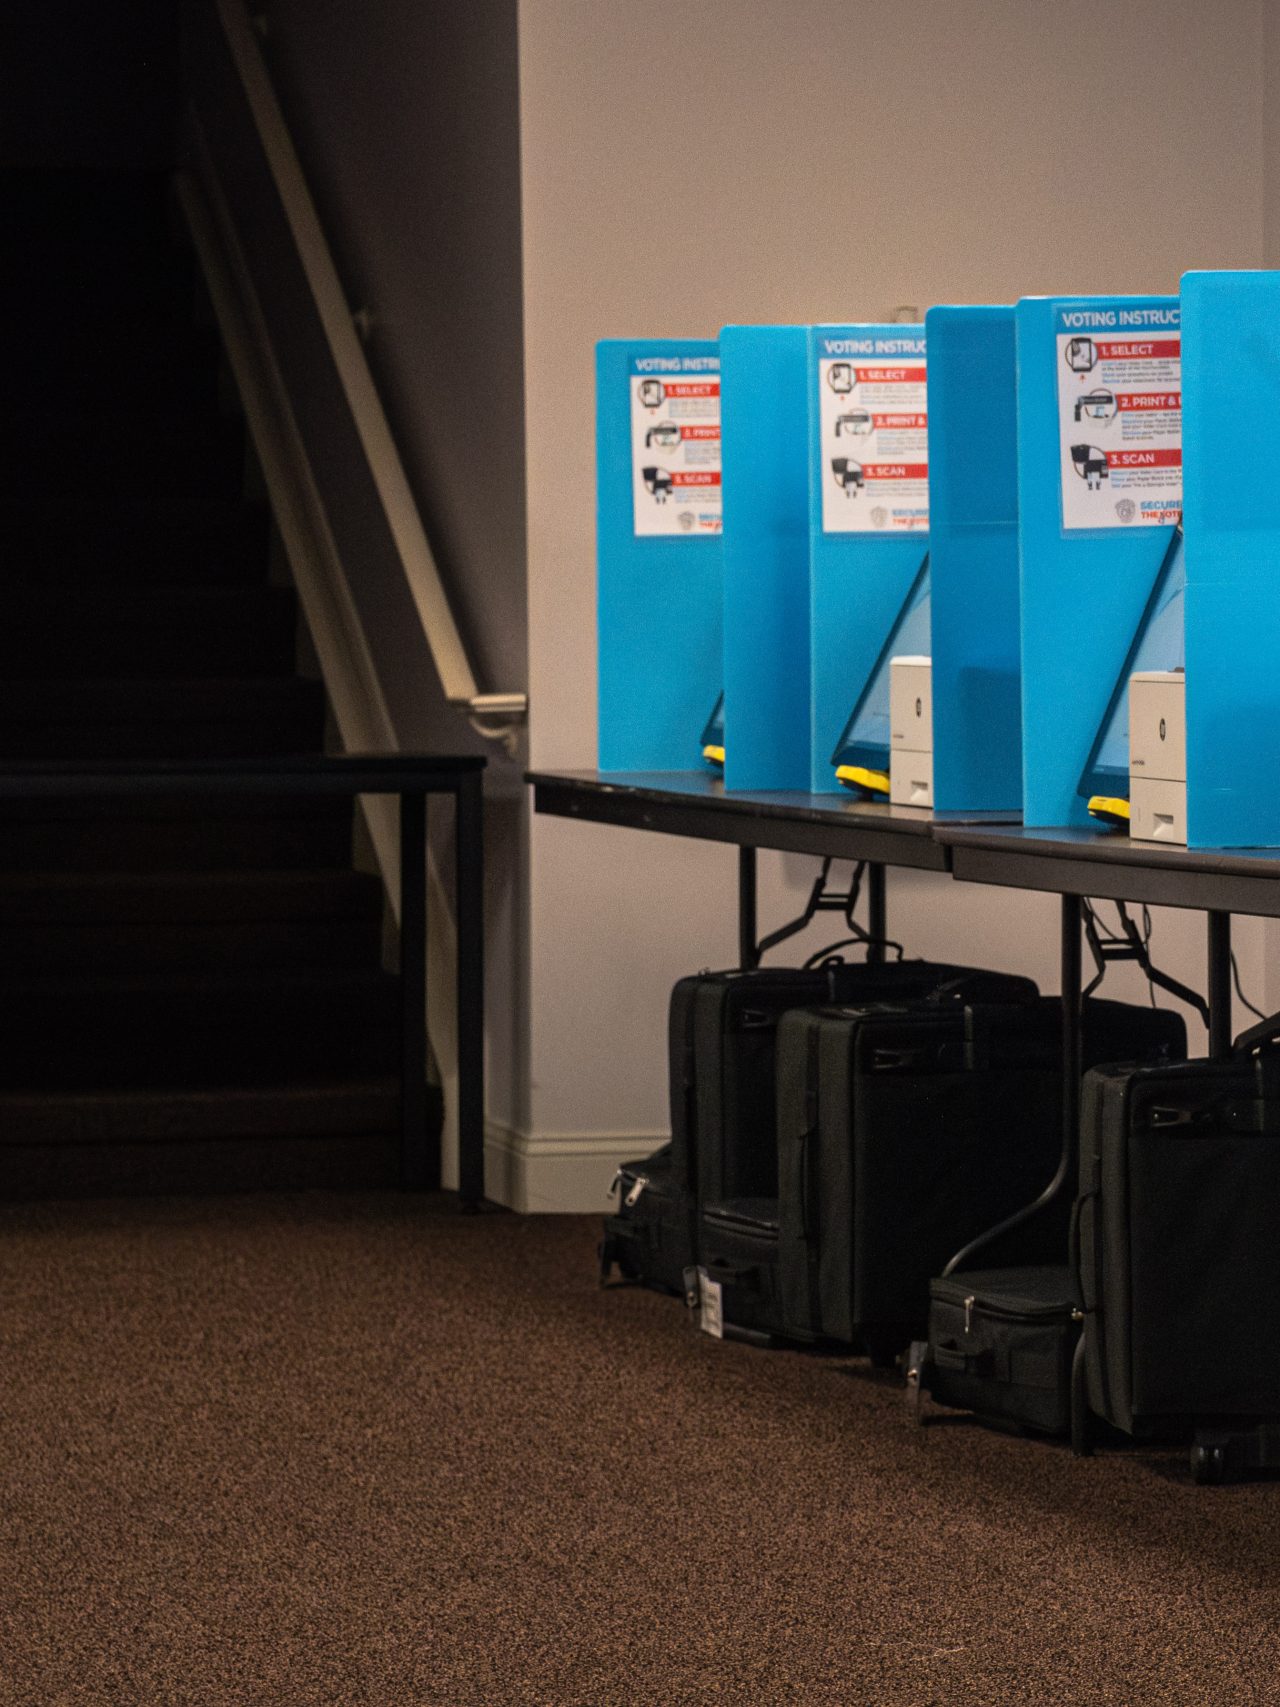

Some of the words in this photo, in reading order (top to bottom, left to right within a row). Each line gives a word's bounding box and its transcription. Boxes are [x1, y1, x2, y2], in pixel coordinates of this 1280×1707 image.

[1062, 311, 1117, 327] VOTING
[1119, 309, 1181, 325] INSTRUC
[824, 339, 874, 354] VOTING
[1102, 346, 1110, 356] 1.
[1111, 344, 1154, 356] SELECT
[635, 357, 681, 371] VOTING
[868, 370, 906, 380] SELECT
[1121, 397, 1131, 408] 2.
[1132, 395, 1167, 407] PRINT
[1168, 395, 1176, 406] &
[1111, 455, 1121, 465] 3.
[1122, 454, 1155, 464] SCAN
[876, 466, 906, 476] SCAN
